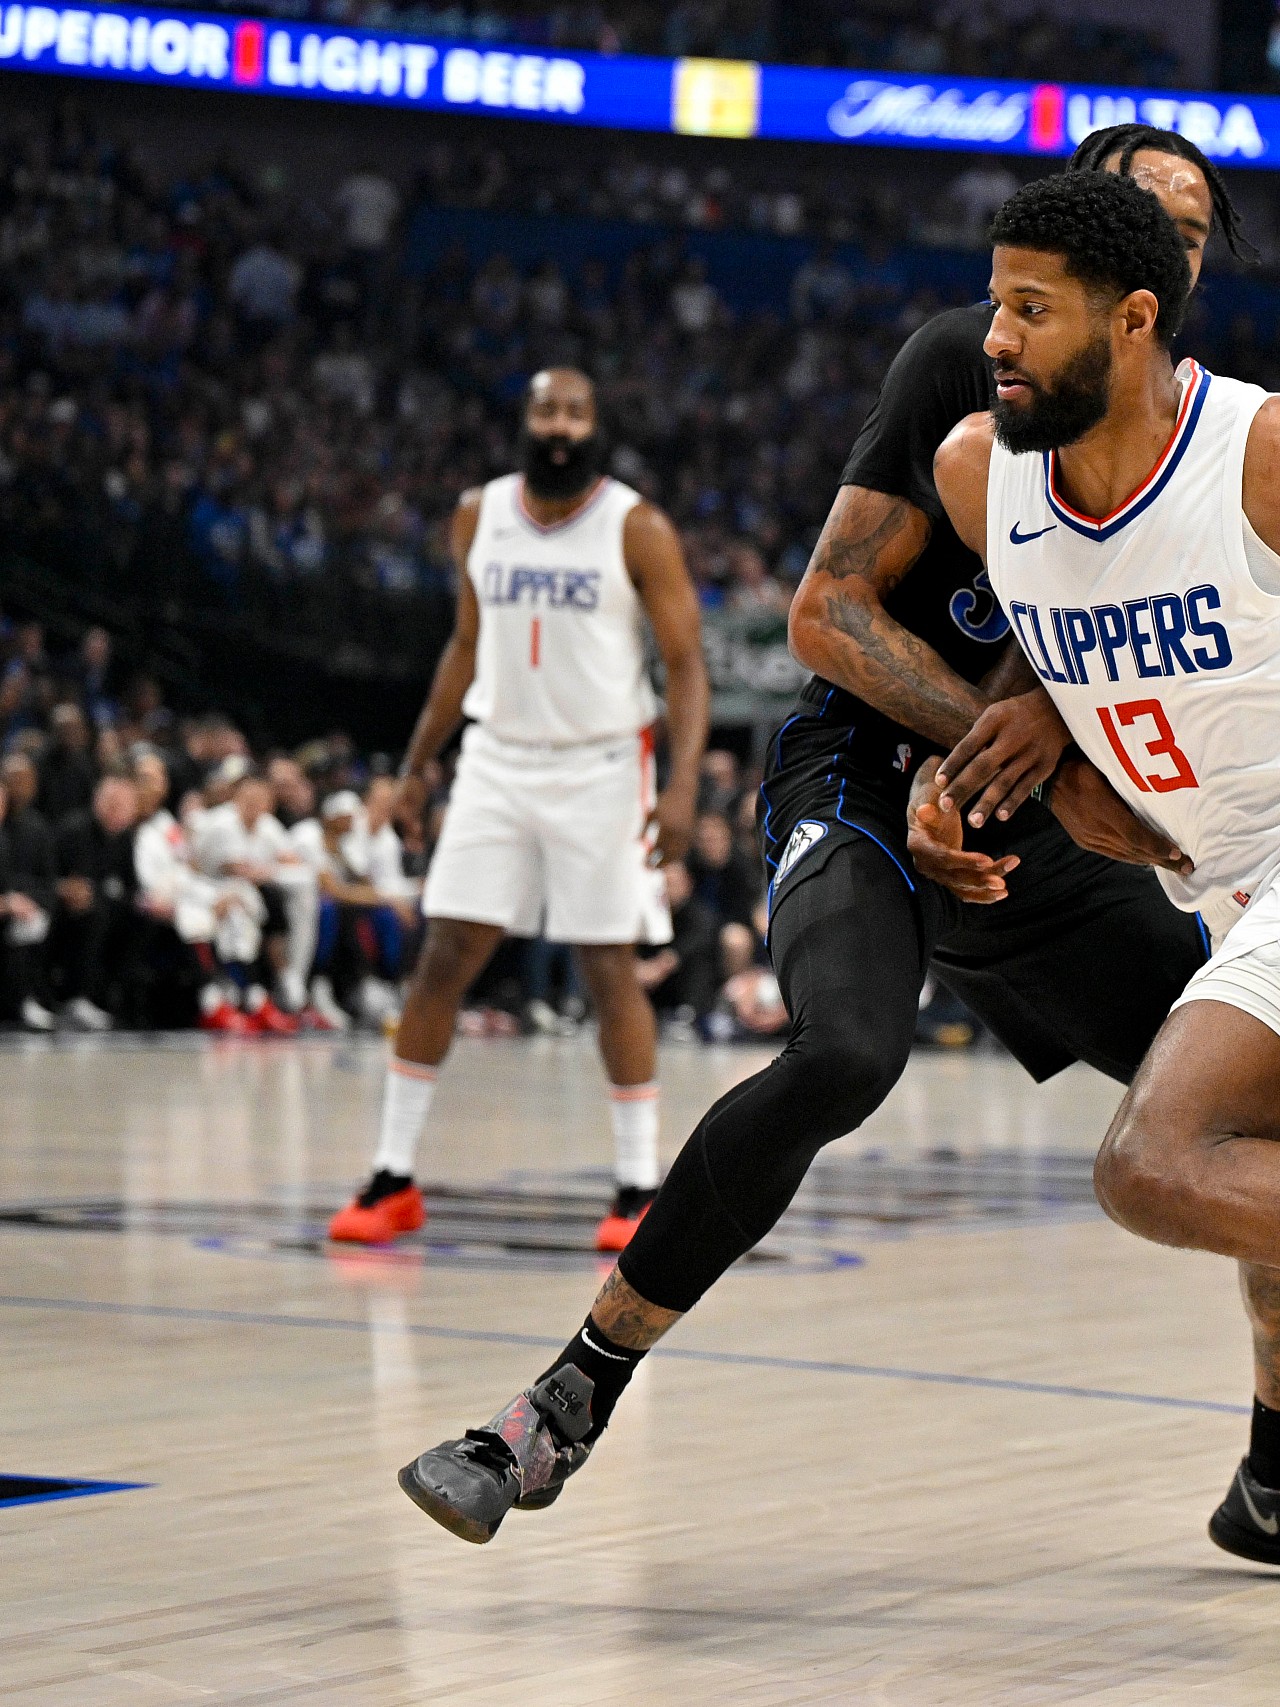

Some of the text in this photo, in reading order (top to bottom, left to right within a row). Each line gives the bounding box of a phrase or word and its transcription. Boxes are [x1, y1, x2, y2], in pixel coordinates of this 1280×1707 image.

[267, 31, 437, 99] LIGHT
[442, 50, 586, 114] BEER
[529, 615, 542, 671] 1
[1009, 584, 1233, 685] CLIPPERS
[1096, 698, 1199, 793] 13
